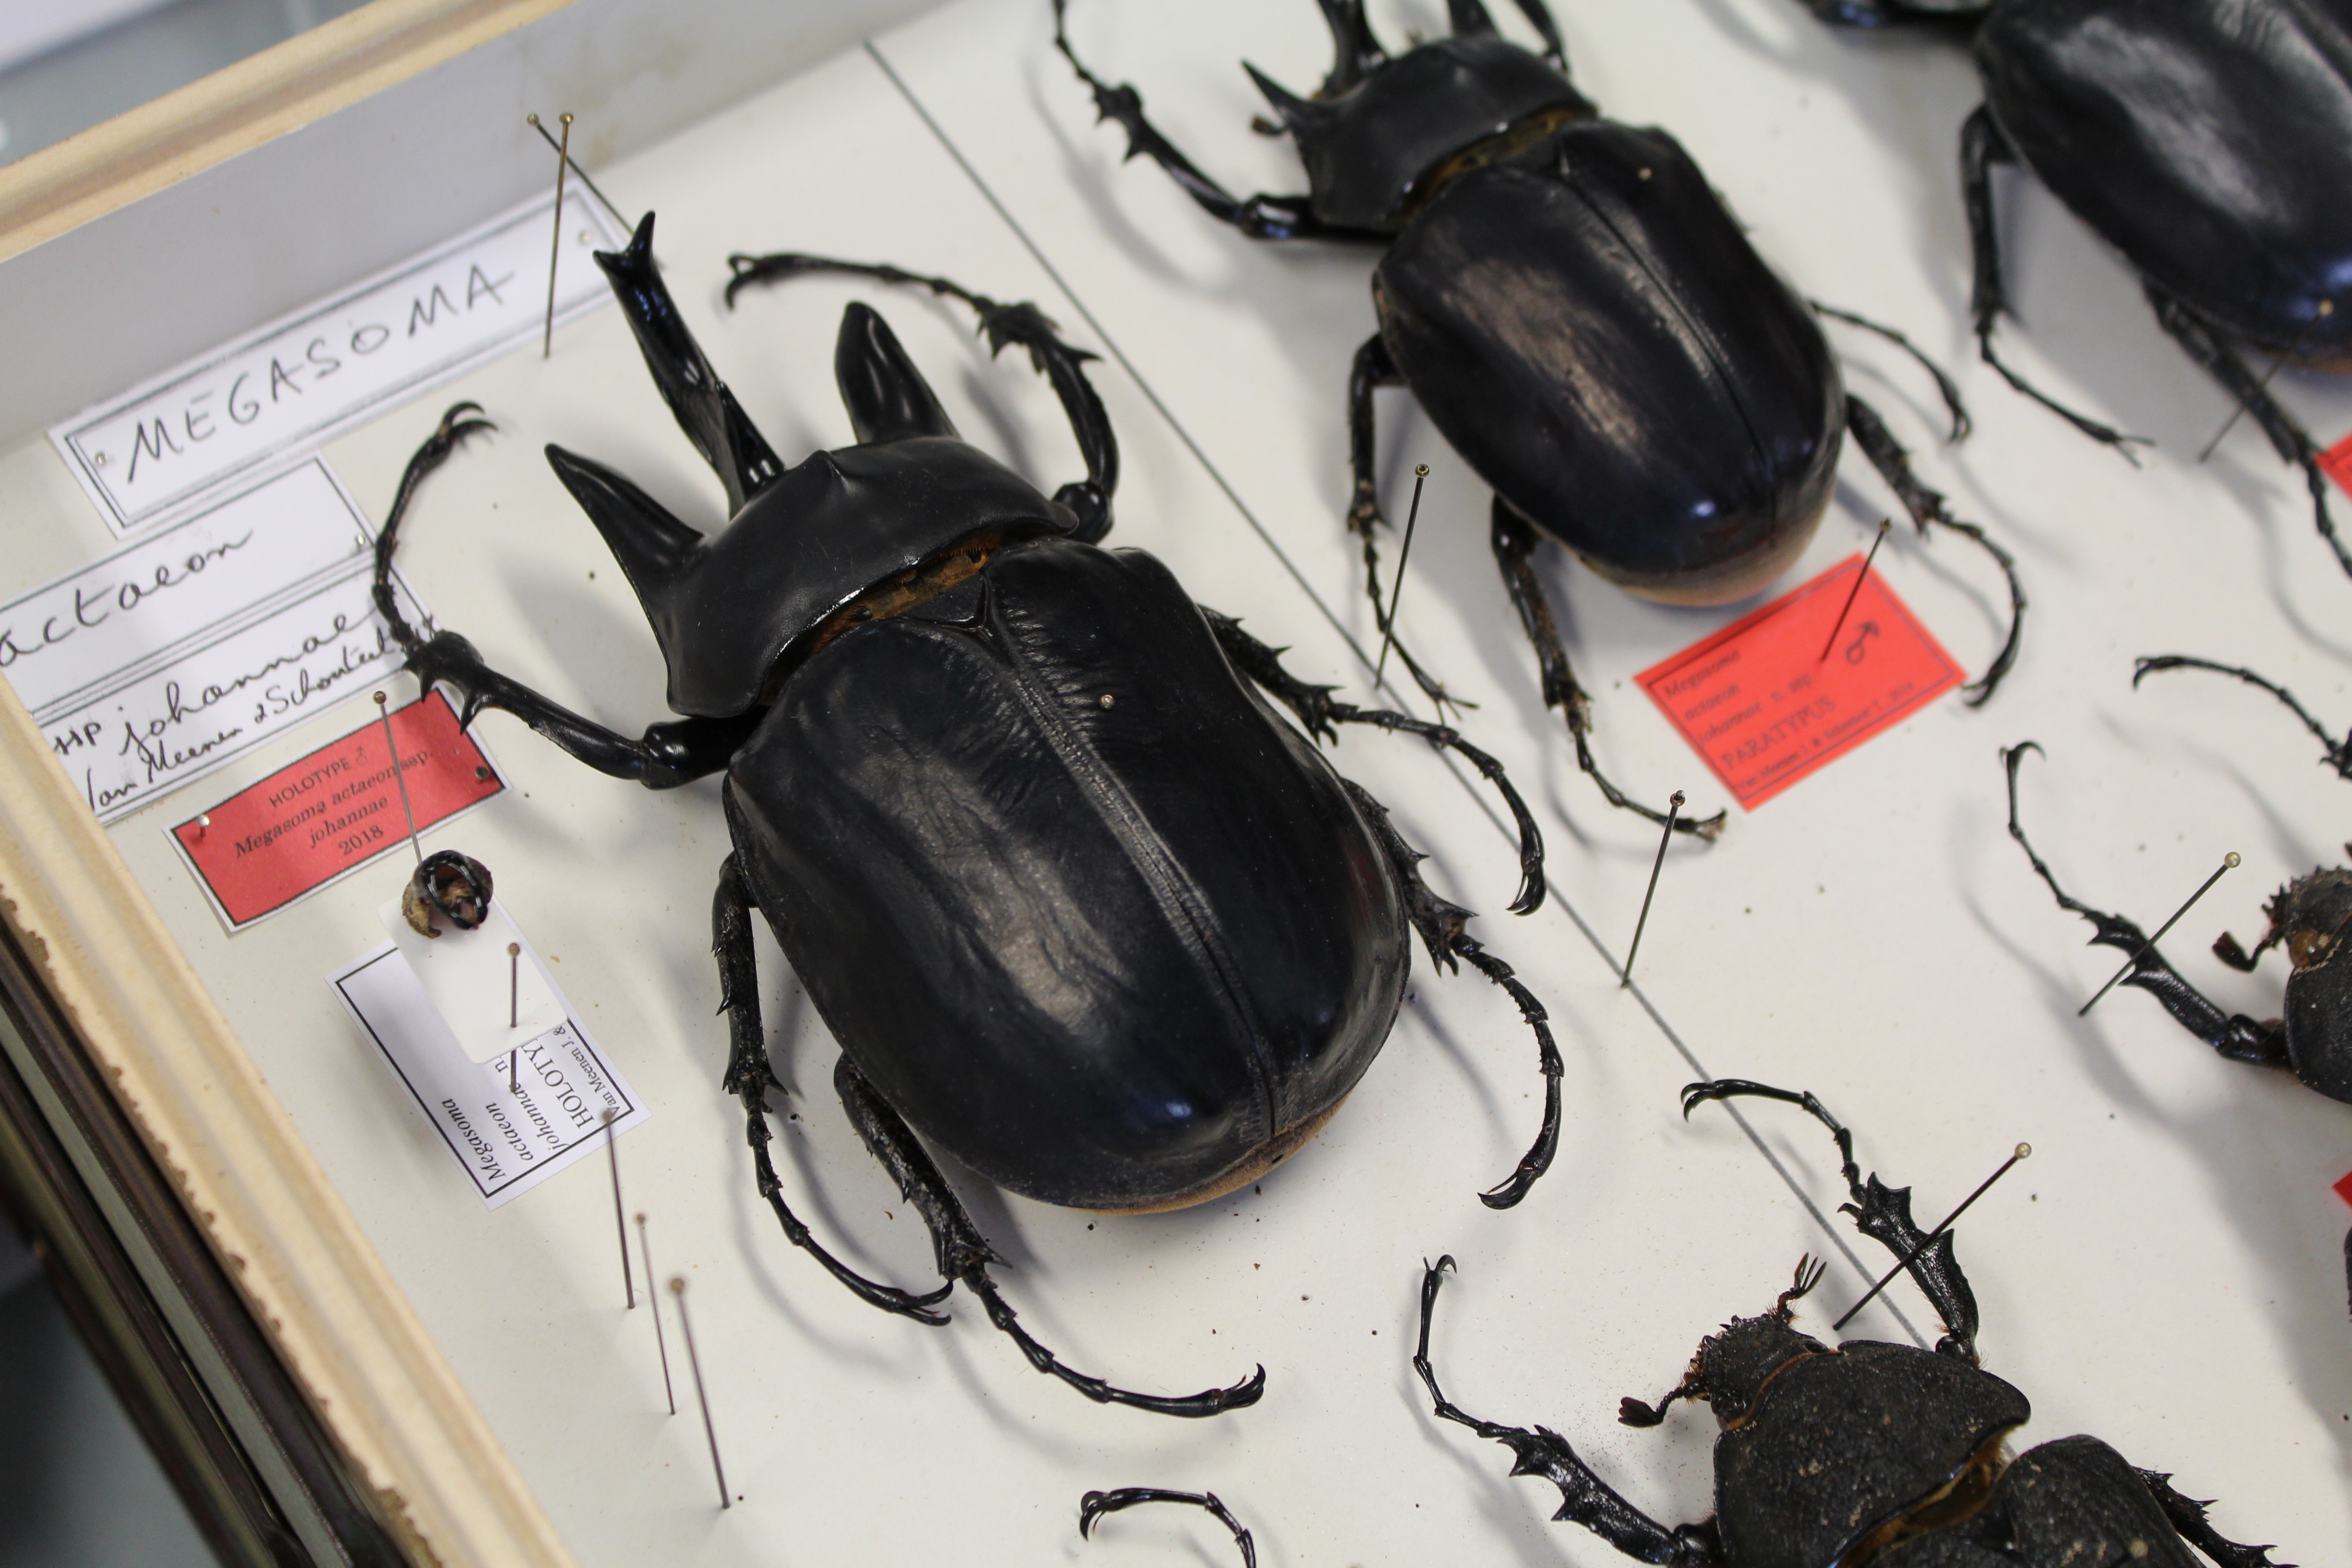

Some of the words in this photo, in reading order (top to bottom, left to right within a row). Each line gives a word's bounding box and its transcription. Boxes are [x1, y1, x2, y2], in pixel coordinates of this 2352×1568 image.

[127, 264, 516, 484] MEGASOMA
[0, 529, 254, 666] actaeon
[1721, 693, 1837, 770] PARATYPUS
[234, 799, 328, 859] Megasoma
[332, 764, 398, 806] actaeon
[269, 757, 352, 808] HOLOTYPE
[311, 796, 389, 848] johannae
[338, 825, 384, 856] 2018
[520, 1038, 595, 1129] HOLOTY
[571, 1046, 607, 1092] Meenen
[441, 1098, 506, 1181] Megasoma
[485, 1101, 534, 1161] actaeon
